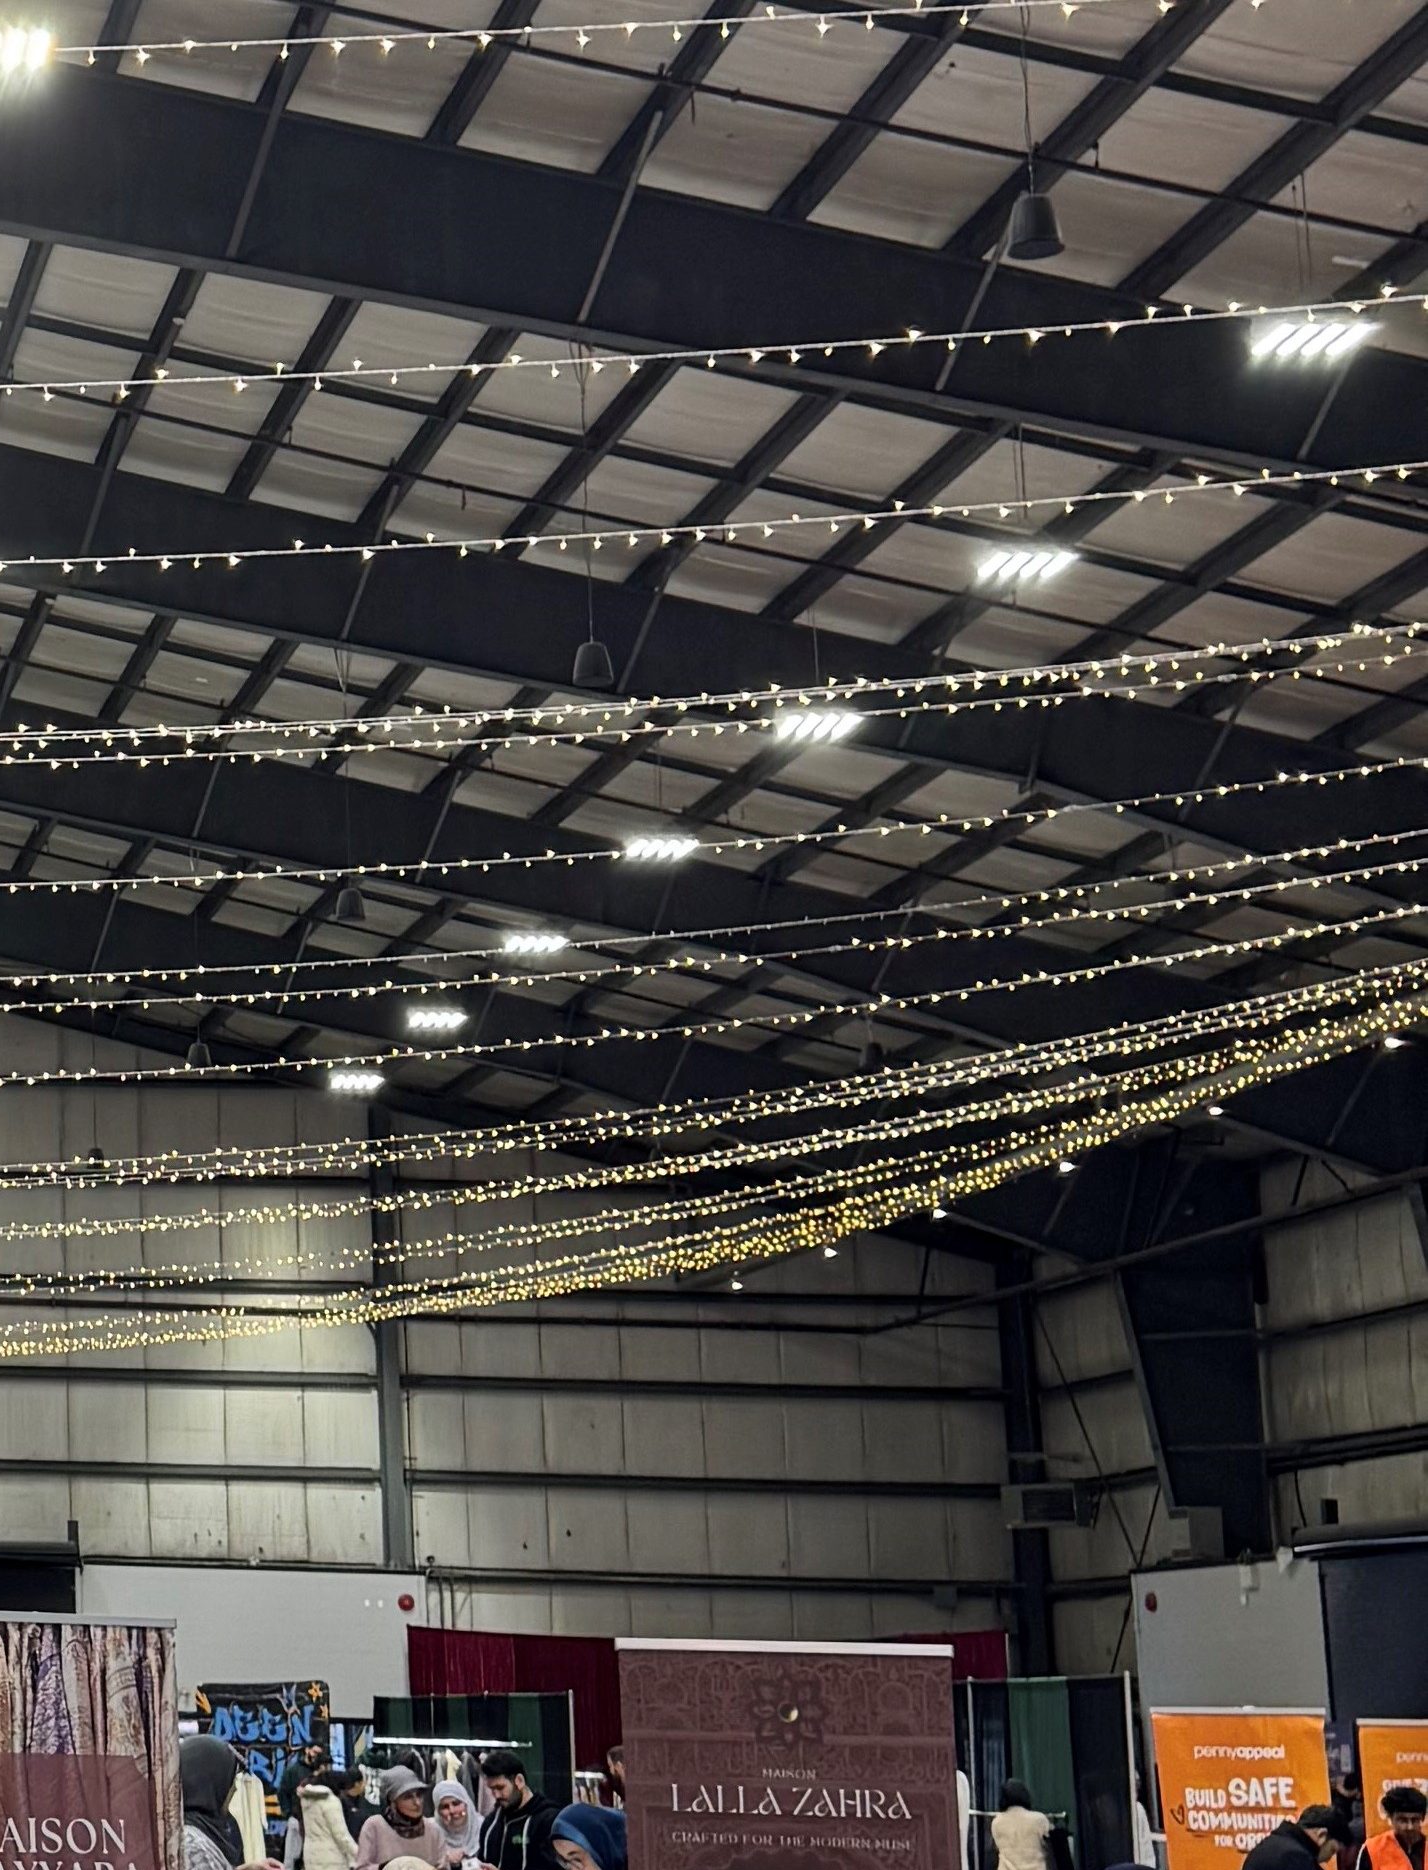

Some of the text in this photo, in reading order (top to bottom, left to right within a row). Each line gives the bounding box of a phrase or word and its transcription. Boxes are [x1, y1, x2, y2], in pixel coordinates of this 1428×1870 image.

[1194, 1744, 1285, 1761] pennyappeal
[762, 1768, 817, 1780] MAISON
[671, 1783, 912, 1820] LALLA ZAHRA
[1185, 1777, 1296, 1809] BUILD SAFE
[672, 1831, 912, 1851] CRAFTED FOR THE MODERN MUSE
[1214, 1834, 1233, 1848] FOR
